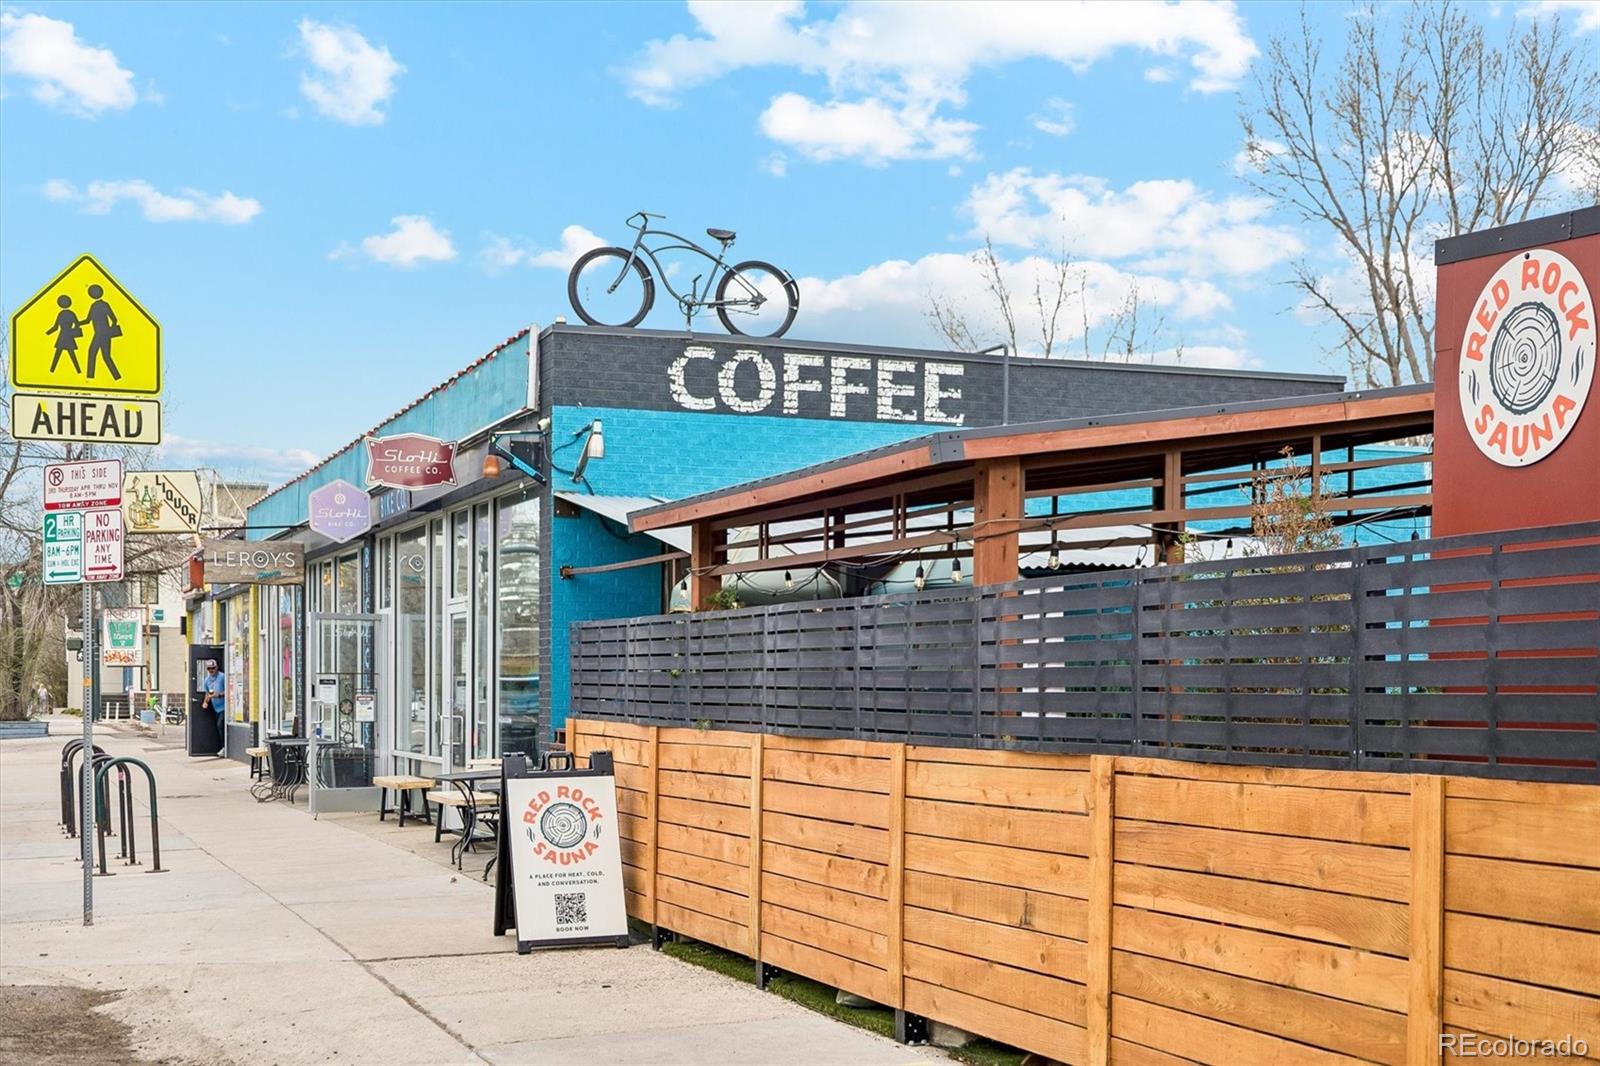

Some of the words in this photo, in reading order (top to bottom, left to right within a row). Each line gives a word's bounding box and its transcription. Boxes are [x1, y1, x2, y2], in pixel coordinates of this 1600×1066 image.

[1466, 278, 1510, 361] RED
[1521, 259, 1589, 341] ROCK
[667, 346, 965, 426] COFFEE
[31, 402, 143, 438] AHEAD
[1474, 394, 1576, 456] SAUNA
[71, 469, 86, 480] THIS
[92, 467, 107, 478] SIDE
[384, 465, 421, 474] COFFEE
[425, 466, 442, 475] CO.
[155, 474, 197, 525] LIQUOR
[46, 519, 56, 538] 2
[63, 515, 74, 526] HR
[95, 513, 110, 527] NO
[58, 527, 80, 538] PARKING
[86, 528, 120, 543] PARKING
[95, 544, 111, 553] ANY
[94, 554, 112, 564] TIME
[213, 550, 296, 568] LEROY'S
[523, 790, 551, 824] RED
[557, 785, 603, 822] ROCK
[533, 840, 599, 866] SAUNA
